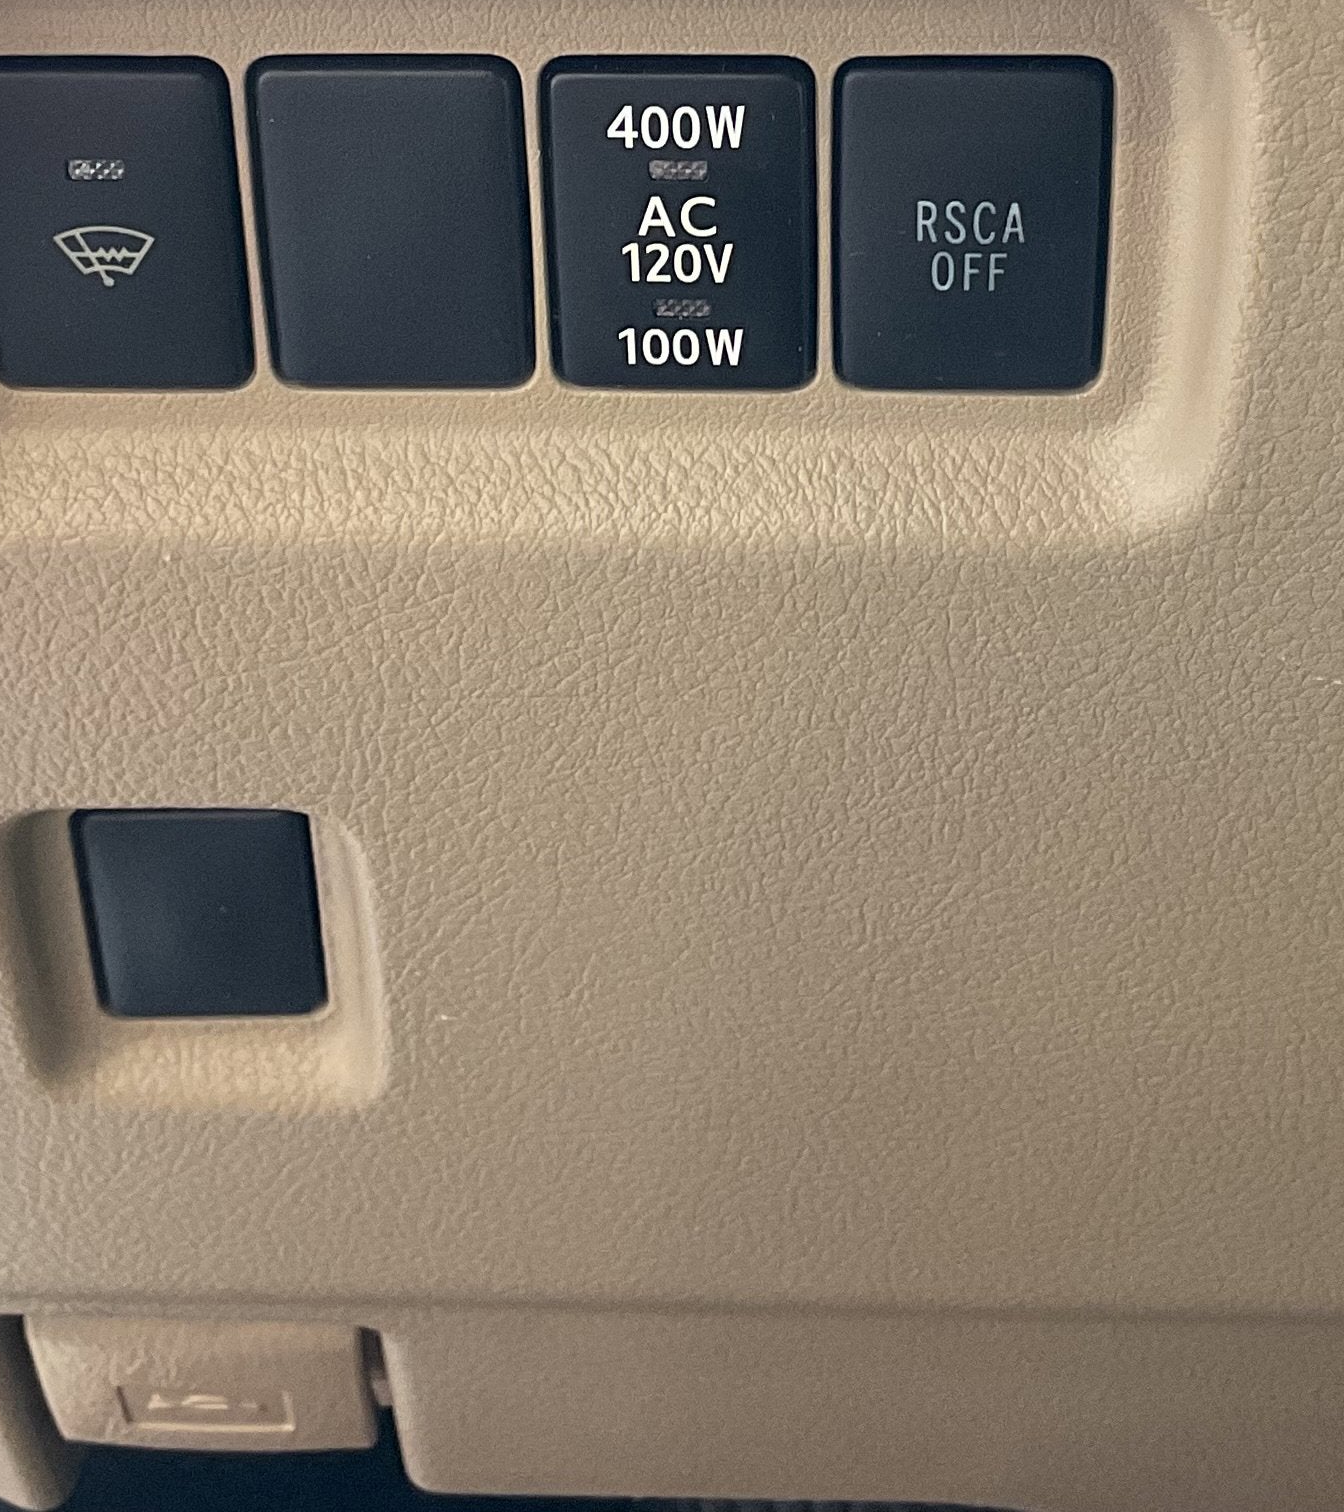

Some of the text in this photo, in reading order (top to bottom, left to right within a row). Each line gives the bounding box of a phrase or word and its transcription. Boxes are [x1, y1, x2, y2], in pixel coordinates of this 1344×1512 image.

[606, 105, 745, 149] 400W
[638, 195, 717, 238] AC
[917, 200, 1025, 245] RSCA
[621, 242, 734, 284] 120V
[931, 251, 1007, 291] OFF
[618, 327, 744, 366] 100W
